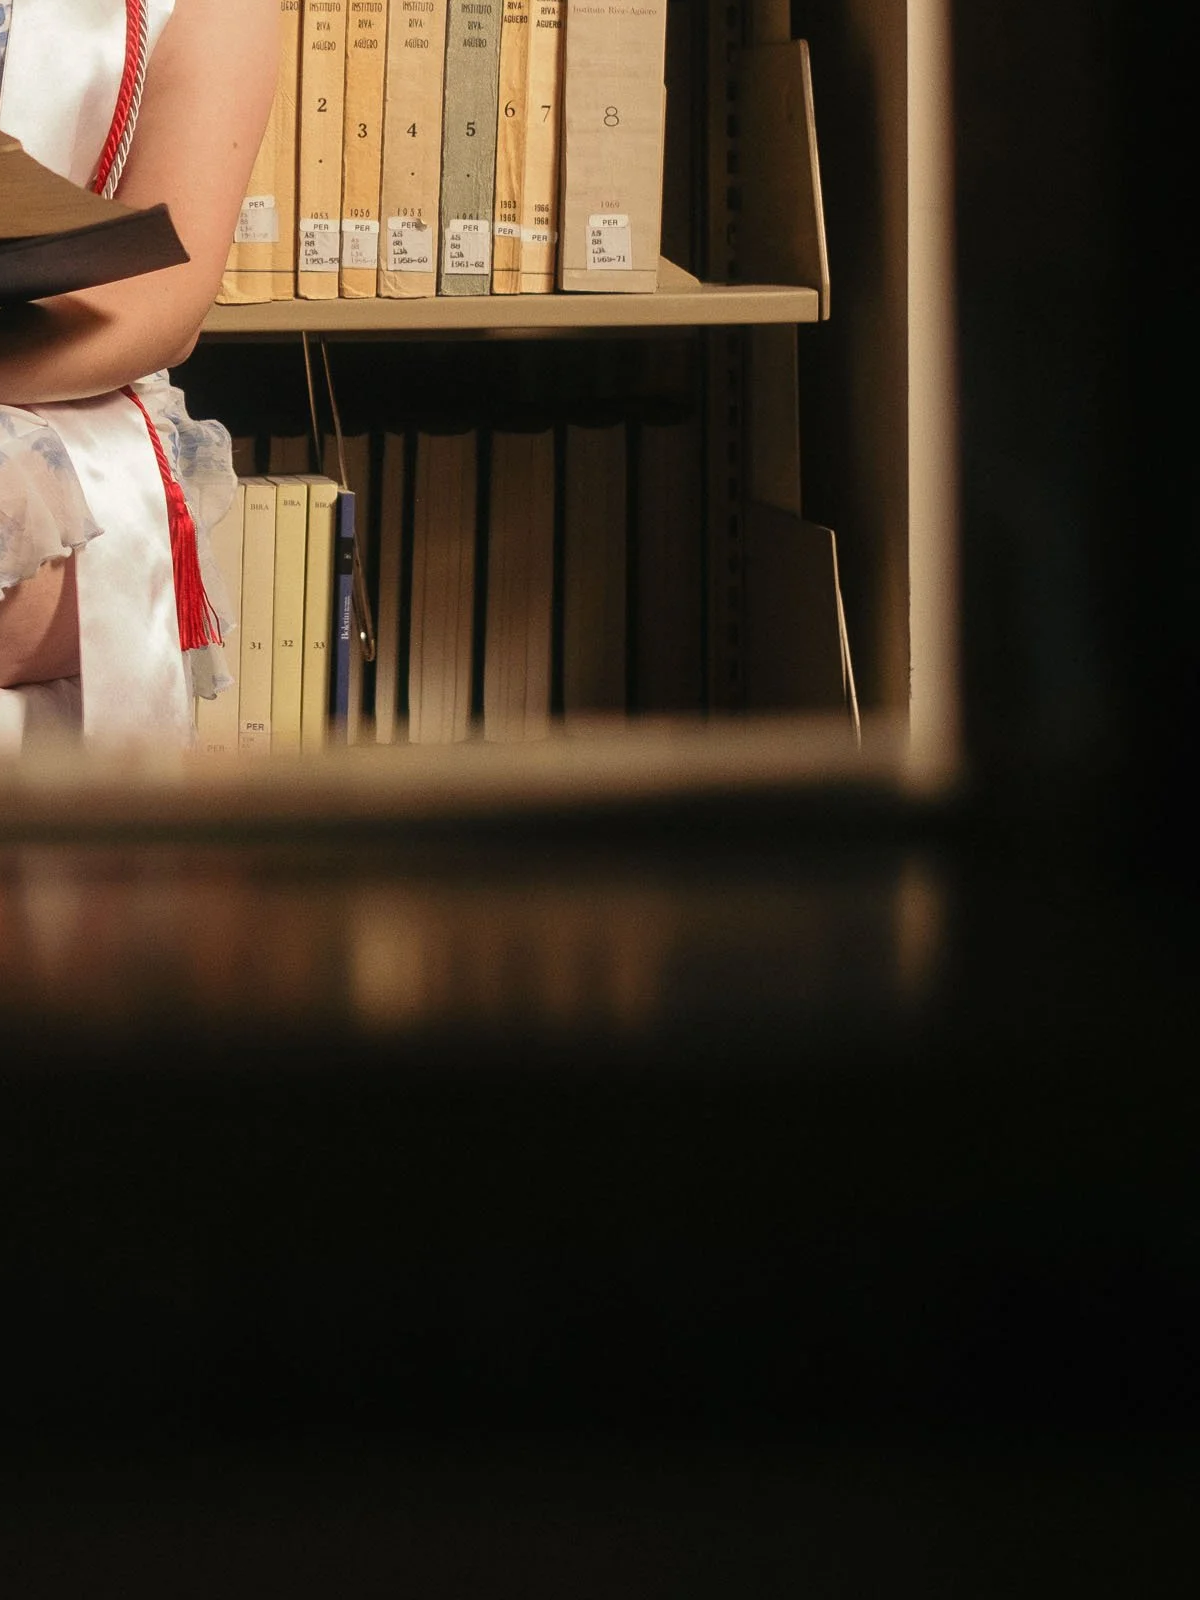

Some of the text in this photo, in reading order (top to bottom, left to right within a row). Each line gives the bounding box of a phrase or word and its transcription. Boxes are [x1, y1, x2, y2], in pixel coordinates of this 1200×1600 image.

[310, 2, 341, 12] INSTITUTO
[352, 2, 382, 12] INSTITUTO
[403, 2, 433, 12] INSTITUTO
[573, 6, 605, 14] Instituto
[317, 99, 327, 113] 2
[504, 100, 516, 118] 6
[541, 105, 552, 123] 7
[604, 106, 620, 127] 8
[357, 123, 368, 139] 3
[406, 122, 418, 138] 4
[466, 122, 476, 137] 5
[500, 200, 517, 209] 1963
[534, 204, 549, 212] 1966
[500, 213, 516, 222] 1965
[534, 217, 549, 225] 1968
[463, 224, 479, 232] PER
[498, 227, 514, 235] PER
[532, 234, 548, 242] PER
[451, 260, 484, 268] 1961-62
[250, 642, 261, 650] 31
[313, 641, 325, 649] 33
[246, 722, 264, 731] PER
